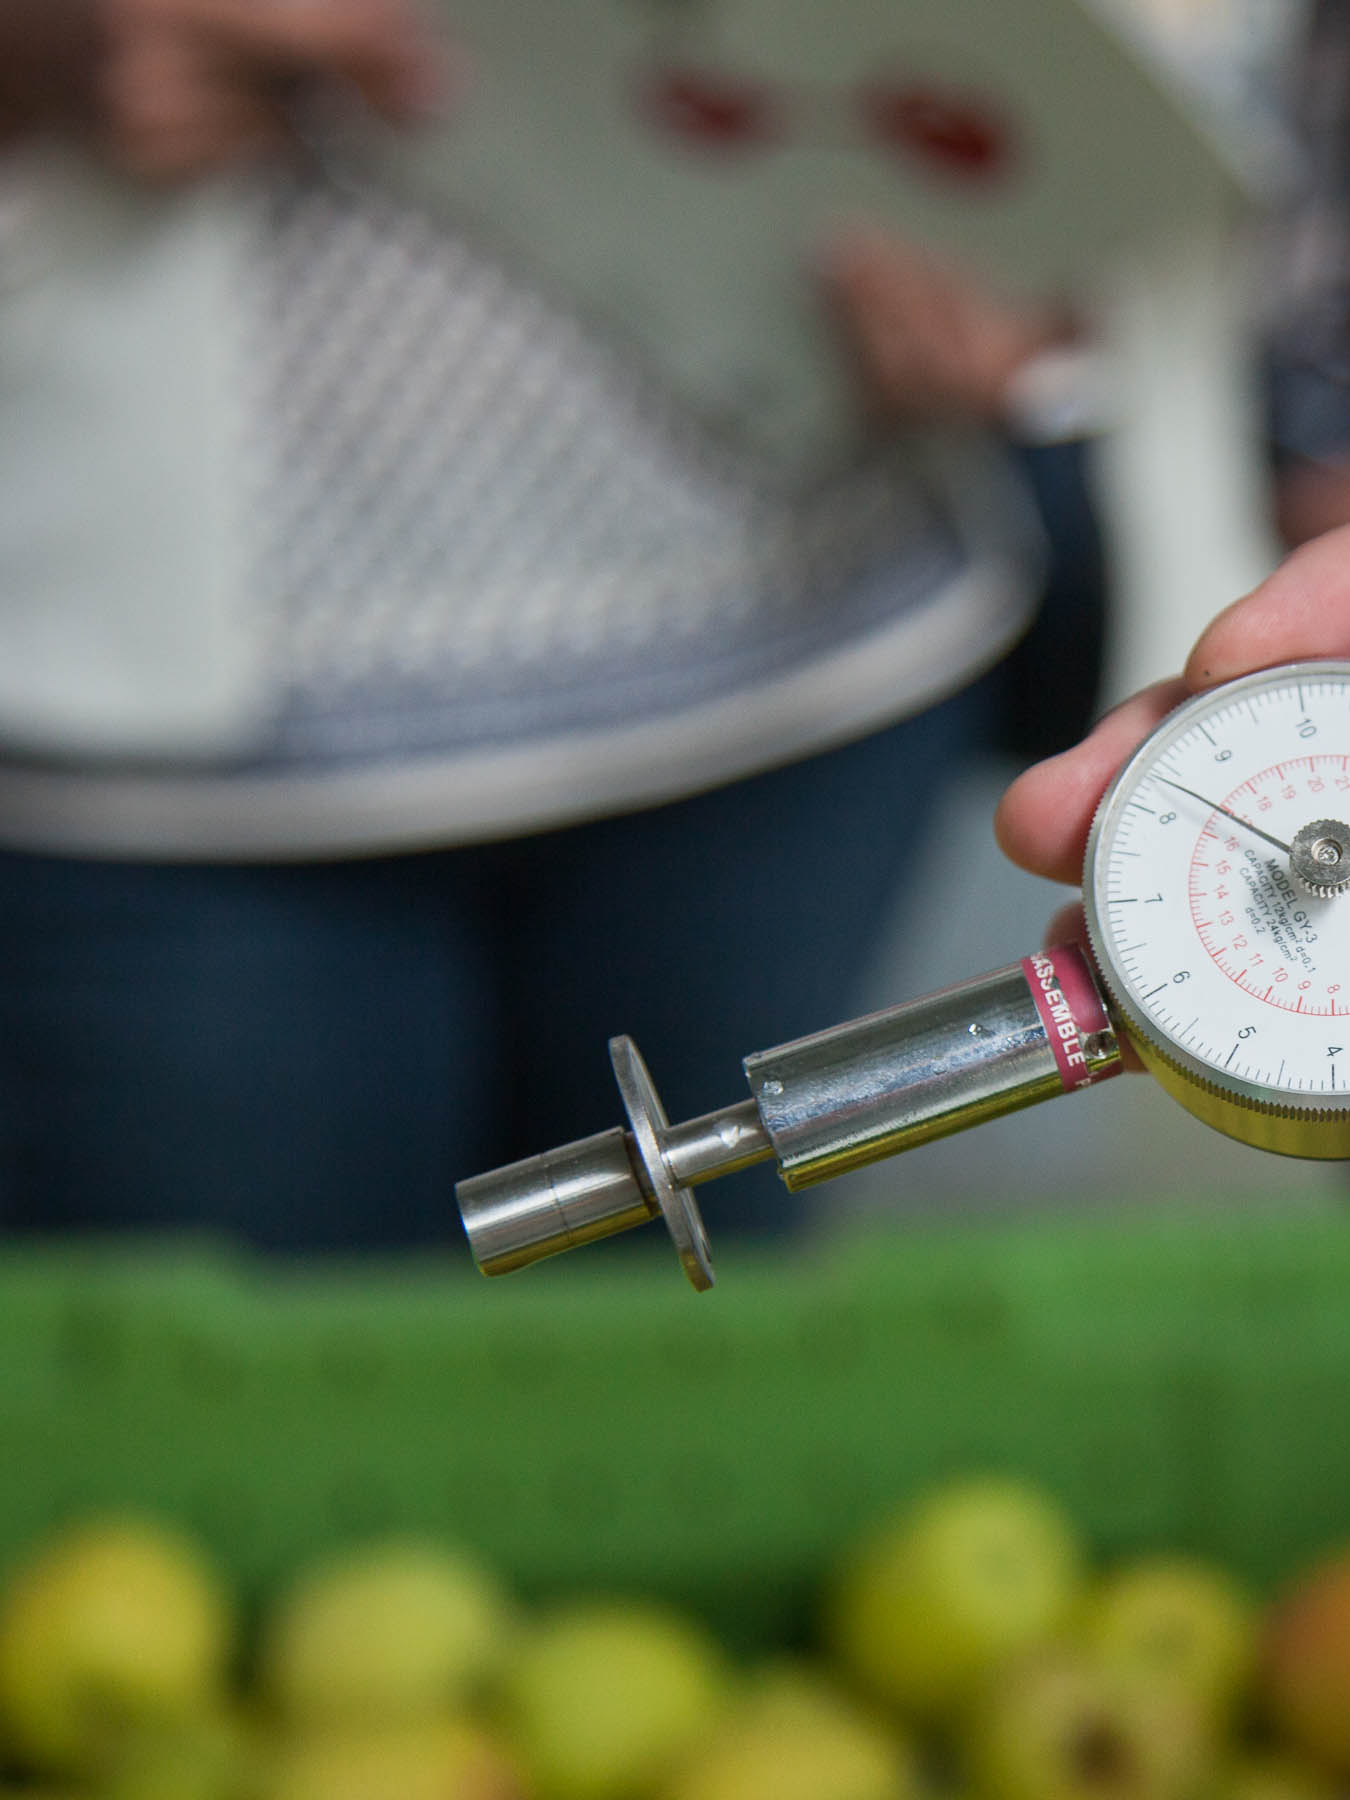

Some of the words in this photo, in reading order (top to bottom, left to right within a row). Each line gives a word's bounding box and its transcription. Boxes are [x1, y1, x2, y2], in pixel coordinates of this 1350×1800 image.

[1296, 719, 1316, 738] 10
[1215, 750, 1232, 761] 9
[1308, 778, 1324, 792] 20
[1336, 778, 1350, 790] 21
[1281, 785, 1296, 800] 19
[1257, 796, 1272, 811] 18
[1160, 811, 1177, 825] 8
[1224, 837, 1240, 851] 16
[1216, 860, 1230, 874] 15
[1244, 849, 1277, 899] CAPACITY
[1144, 893, 1164, 903] 7
[1215, 884, 1229, 899] 14
[1239, 867, 1272, 917] CAPACITY
[1263, 858, 1298, 909] MODEL
[1293, 911, 1319, 944] GY-3
[1219, 910, 1234, 926] 13
[1232, 935, 1248, 950] 12
[1250, 954, 1264, 966] 11
[1173, 971, 1190, 983] 6
[1272, 968, 1288, 982] 10
[1298, 981, 1311, 990] 9
[1328, 984, 1340, 994] 8
[1030, 952, 1085, 1067] ASSEMBLE
[1238, 1026, 1256, 1039] 5
[1327, 1047, 1343, 1057] 4
